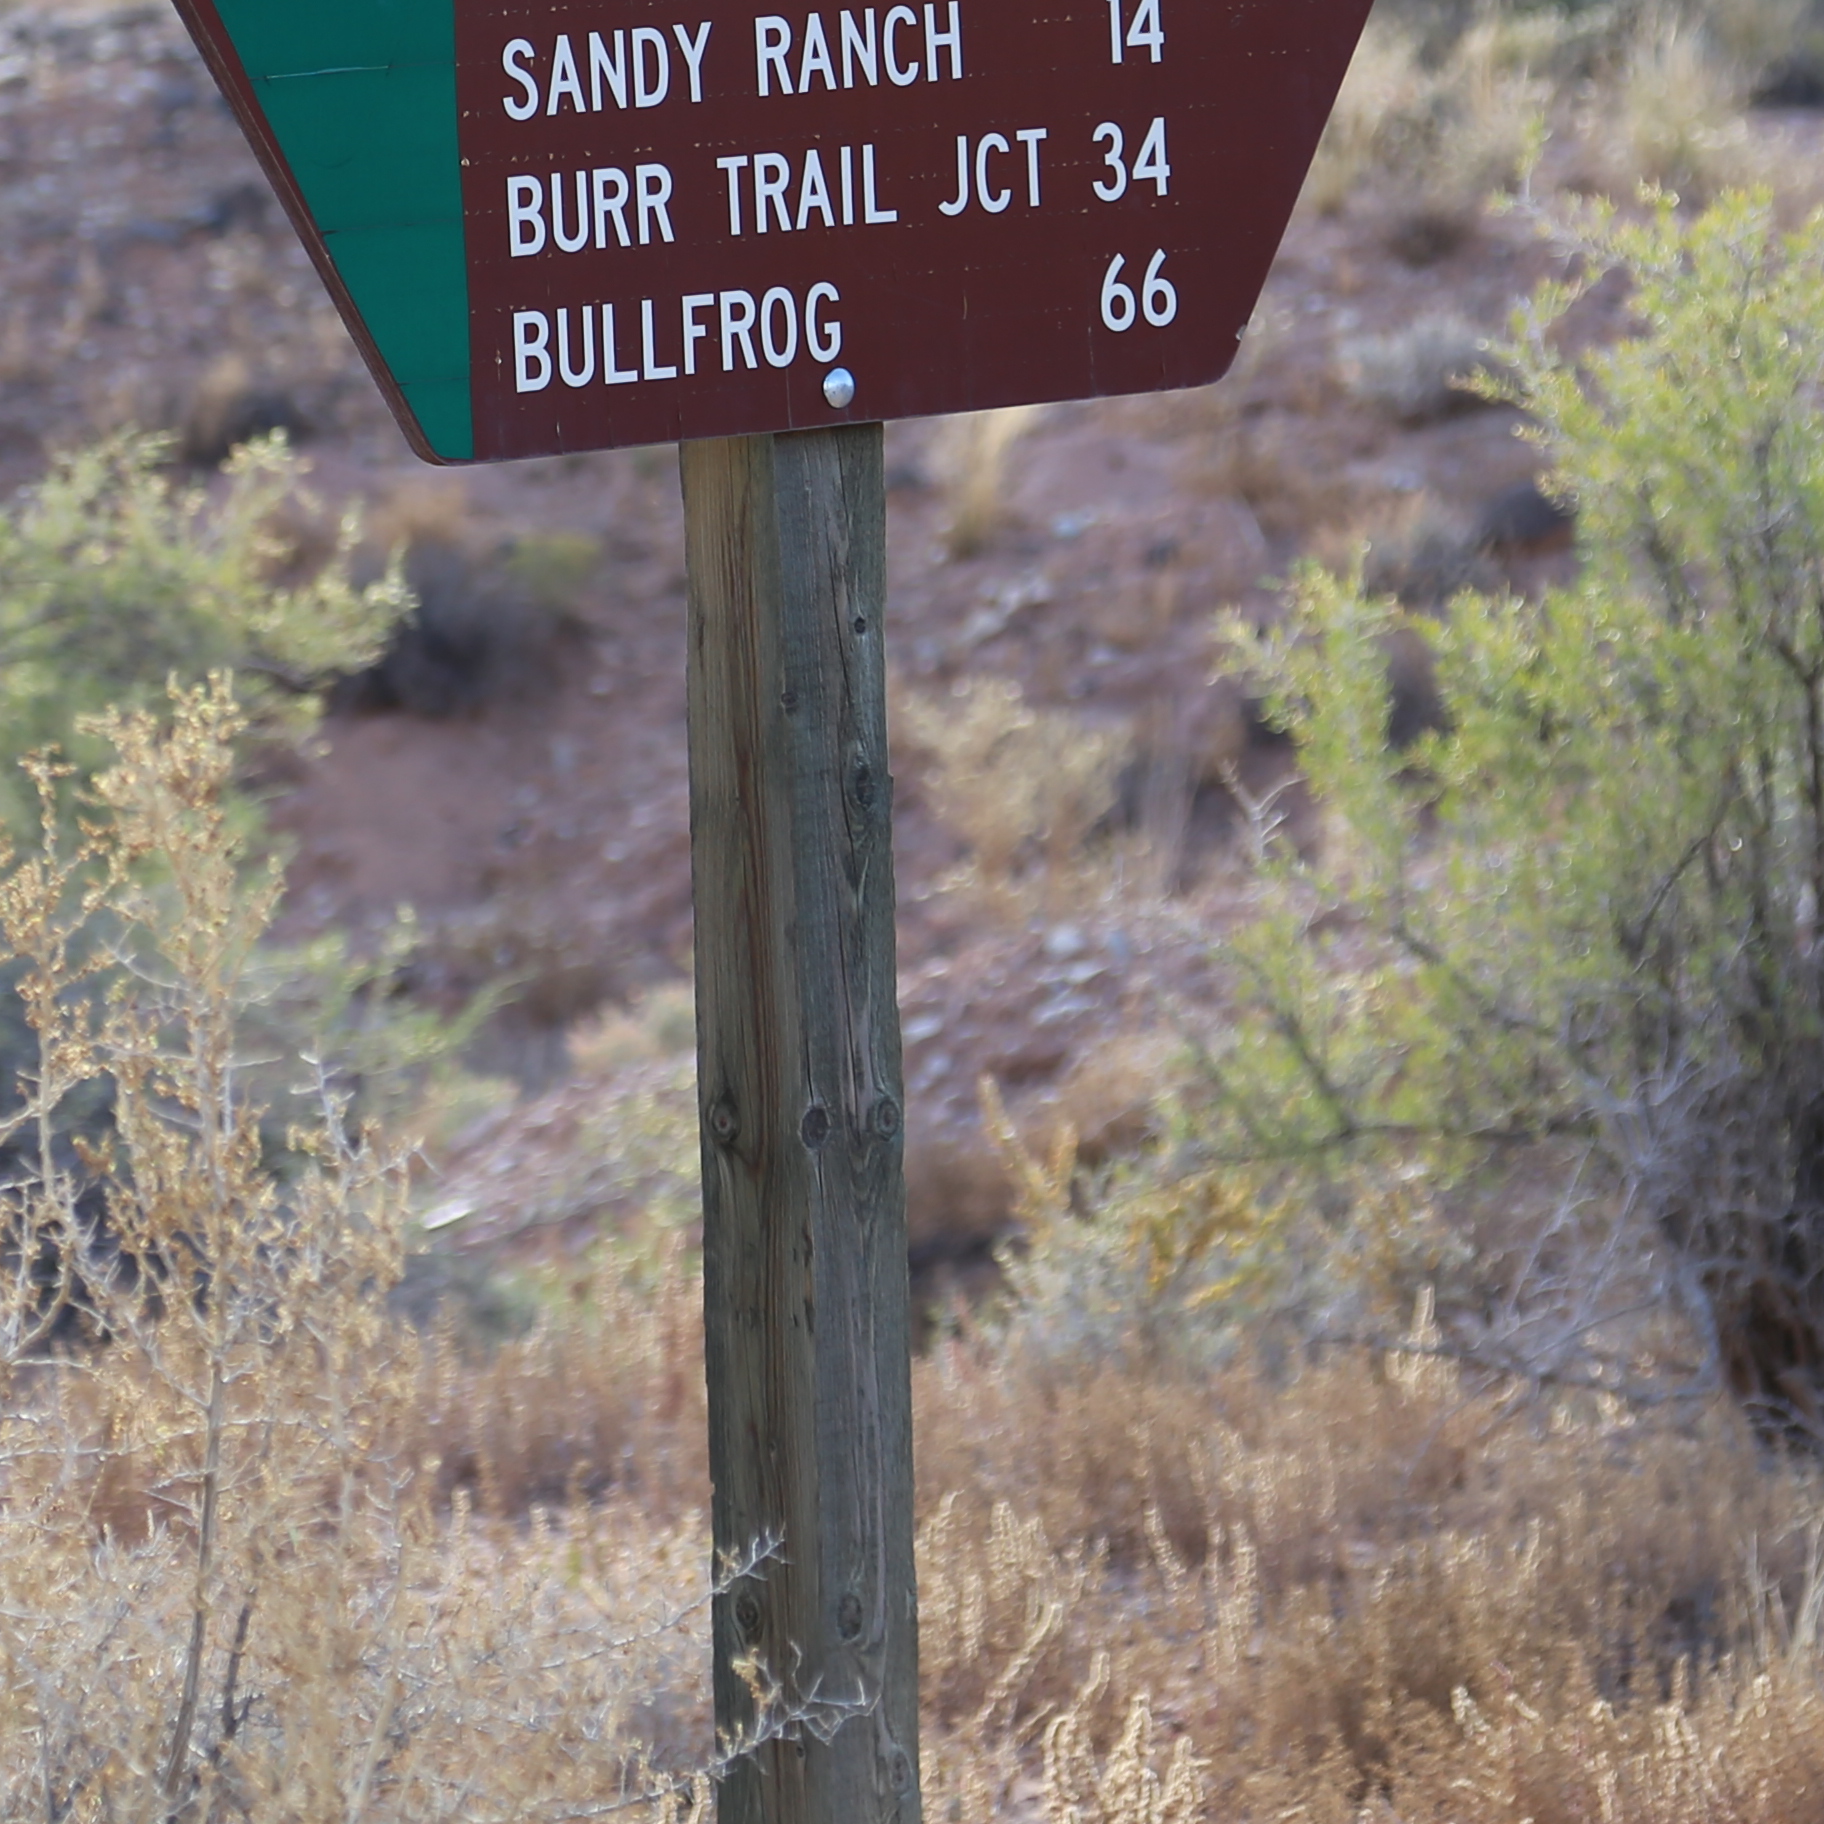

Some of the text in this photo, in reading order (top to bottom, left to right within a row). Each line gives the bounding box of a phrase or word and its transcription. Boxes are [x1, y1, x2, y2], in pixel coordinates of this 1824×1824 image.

[502, 21, 712, 121] SANDY
[754, 0, 962, 97] RANCH
[506, 116, 1171, 258] BURR TRAIL JCT 34
[513, 248, 1177, 393] BULLFROG 66
